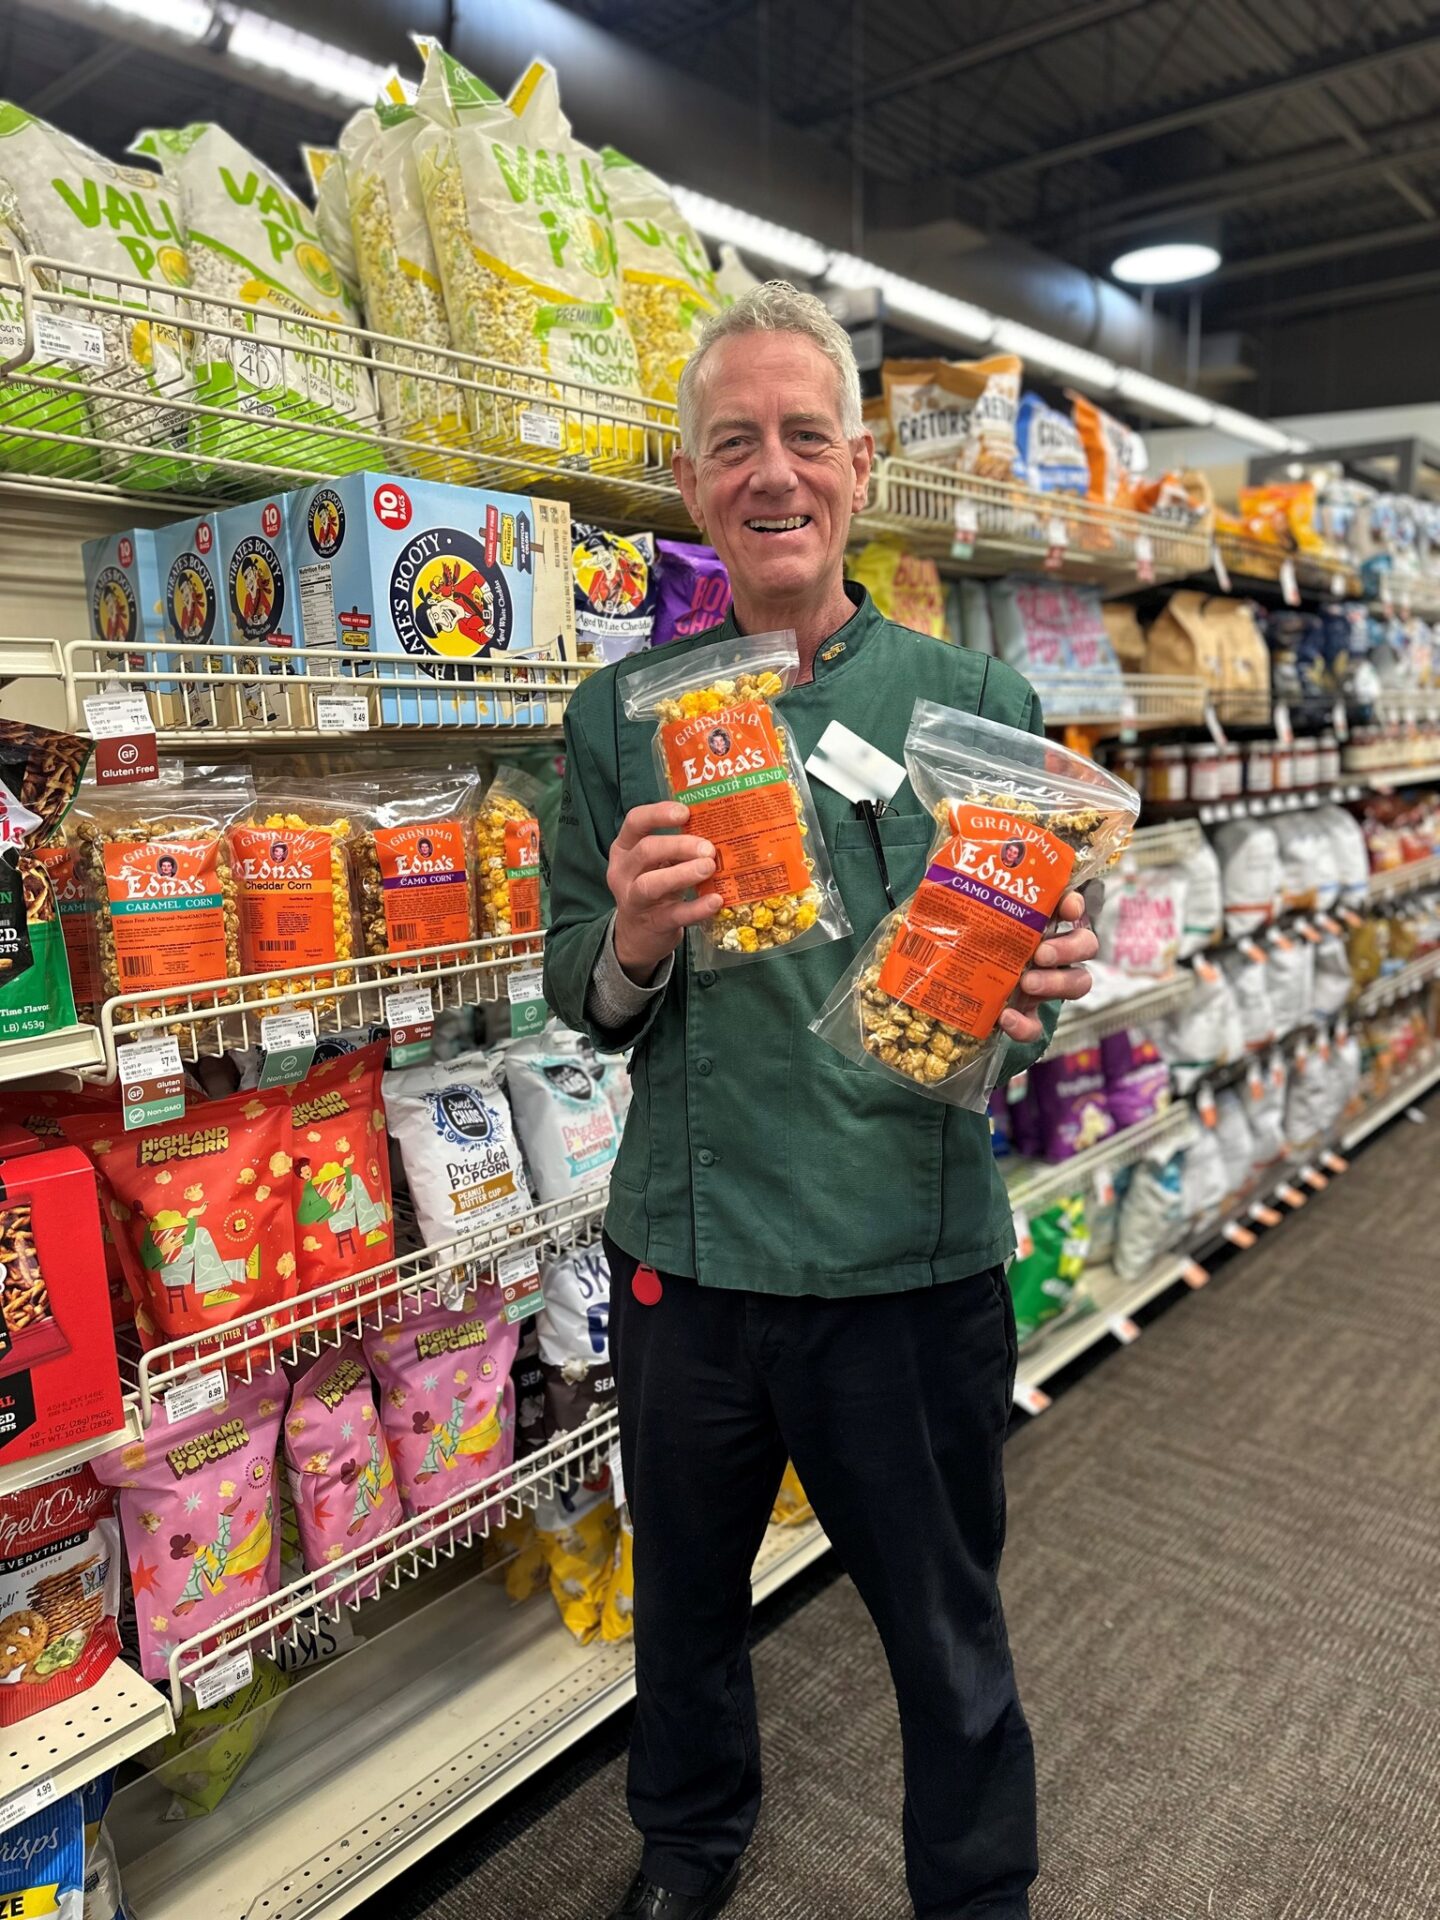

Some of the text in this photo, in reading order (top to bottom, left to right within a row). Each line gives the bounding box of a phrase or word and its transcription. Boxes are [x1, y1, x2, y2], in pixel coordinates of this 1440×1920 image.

[84, 340, 101, 354] 7.49
[380, 490, 399, 519] 10
[264, 508, 278, 525] 10
[198, 526, 210, 542] 10
[255, 539, 282, 577] BOOTY
[394, 533, 440, 592] BOOTY
[189, 556, 214, 591] BOOTY
[675, 711, 762, 747] GRANDMA
[121, 749, 135, 759] GF
[102, 765, 155, 778] Gluten Free
[682, 747, 767, 788] Edna's
[679, 769, 783, 804] MINNESOTA BLEND
[390, 828, 453, 847] GRANDMA
[970, 815, 1060, 866] GRANDMA
[243, 858, 314, 881] Edna's
[395, 854, 455, 876] Edna's
[954, 842, 1041, 906] Edna's
[126, 874, 206, 899] Edna's
[244, 881, 312, 890] Cheddar Corn
[400, 873, 452, 886] CAMO CORN
[126, 897, 213, 912] CARAMEL CORN
[951, 876, 1026, 920] CAMO CORN
[3, 1020, 45, 1034] LB) 453g
[156, 1079, 181, 1089] Gluten
[267, 1070, 303, 1083] Non-GMO
[130, 1090, 142, 1098] GF
[147, 1103, 182, 1116] Non-GMO
[451, 1109, 484, 1126] CHAOS
[446, 1145, 509, 1180] Drizzled
[457, 1184, 486, 1201] PEANUT
[459, 1188, 502, 1210] BUTTER CUP
[208, 1386, 222, 1399] 8.99
[29, 1439, 45, 1448] NET
[47, 1434, 62, 1443] WT.
[90, 1417, 114, 1431] (283g)
[0, 1535, 82, 1571] EVERYTHING
[20, 1555, 63, 1579] DELI STYLE
[249, 1614, 263, 1628] MIX
[236, 1667, 249, 1680] 8.99
[36, 1782, 52, 1798] 4.99
